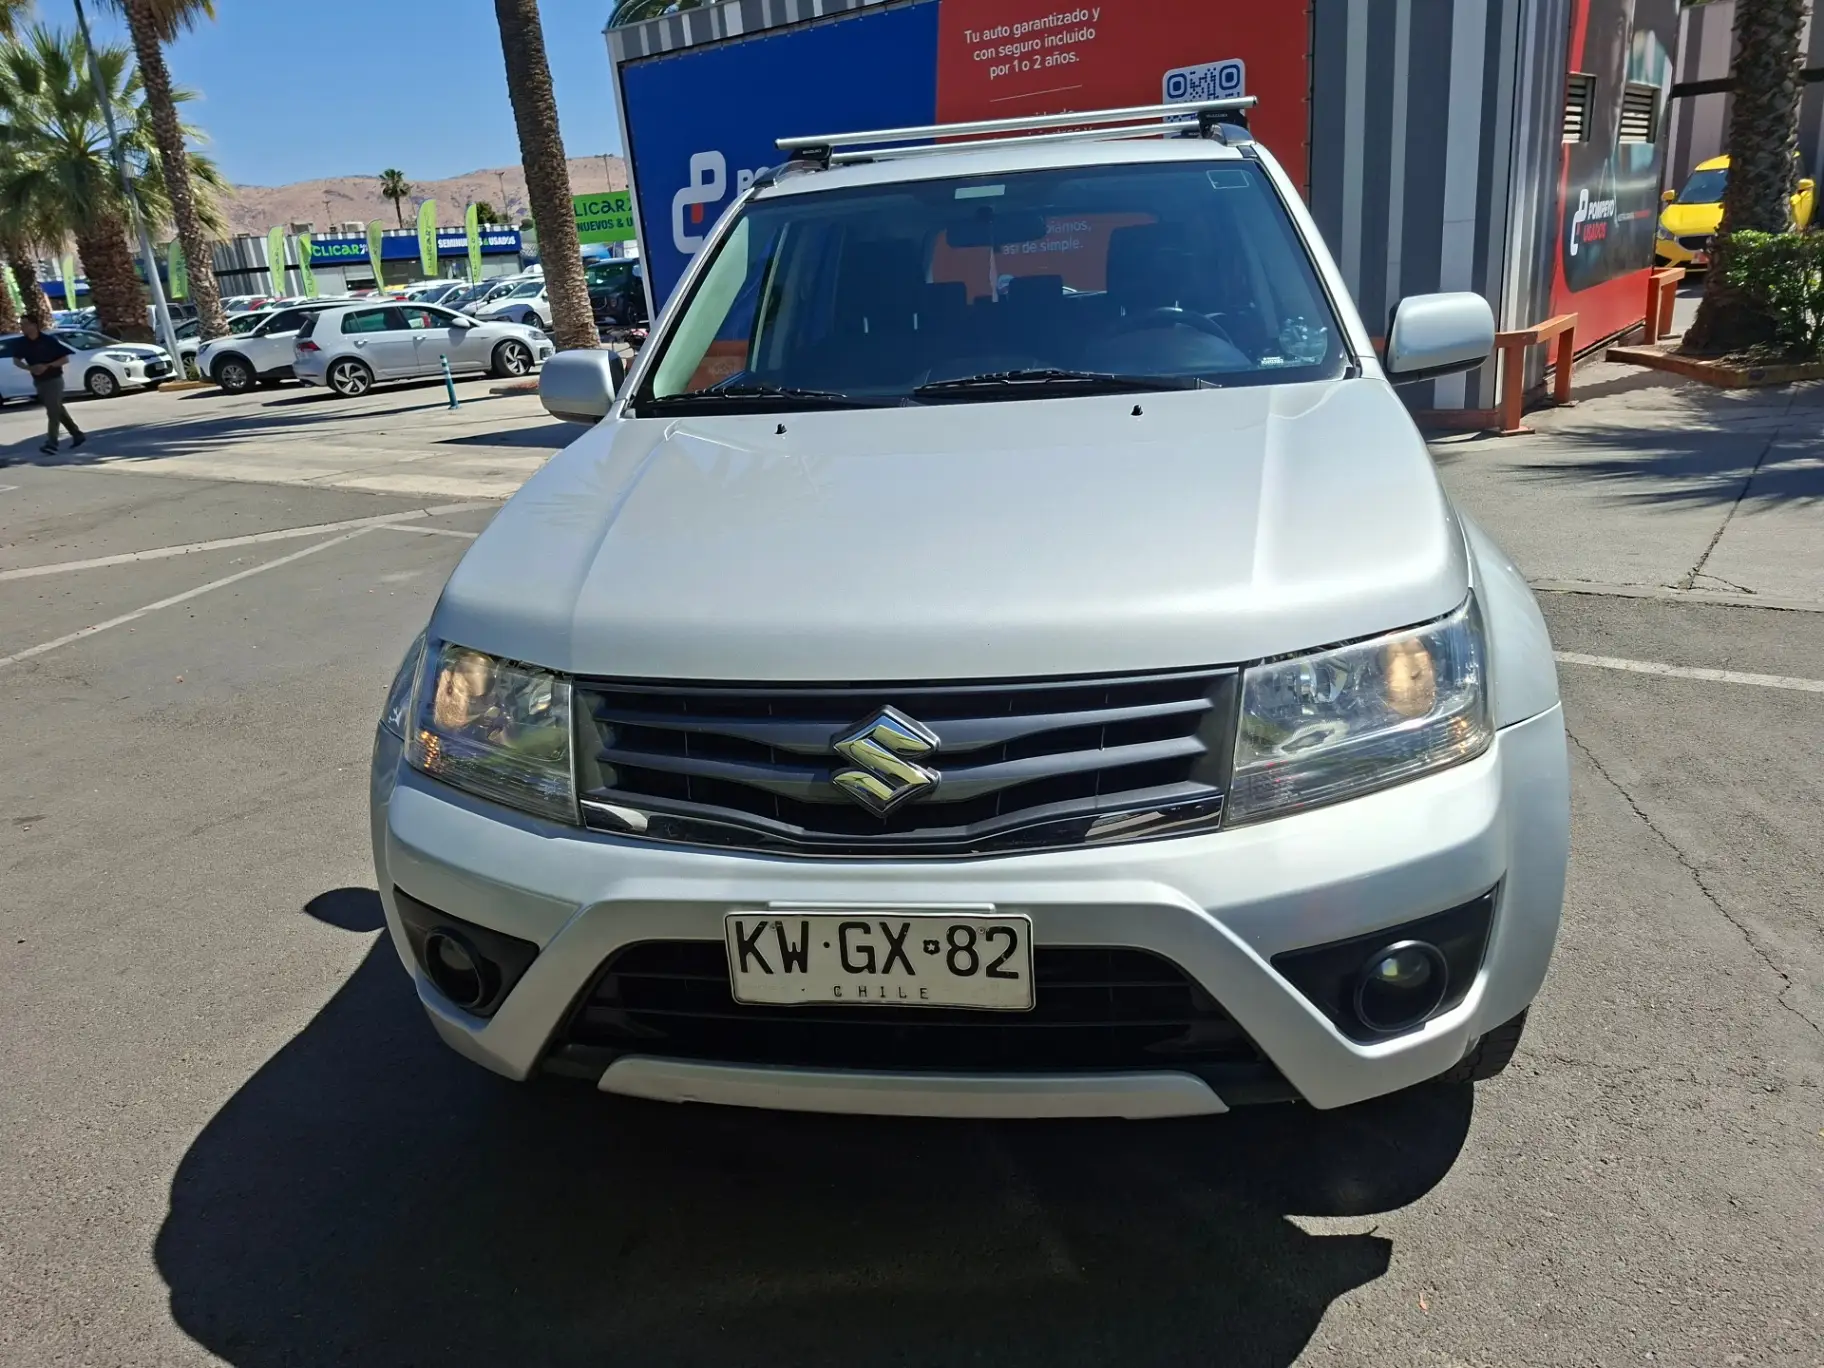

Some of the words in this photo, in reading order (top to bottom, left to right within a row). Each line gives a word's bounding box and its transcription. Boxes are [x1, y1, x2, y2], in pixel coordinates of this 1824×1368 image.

[964, 30, 980, 44] Tu
[982, 26, 1010, 41] auto
[1013, 8, 1089, 38] garantizado
[1092, 7, 1101, 22] y
[973, 48, 996, 61] con
[998, 38, 1041, 57] seguro
[1044, 27, 1096, 48] incluido
[989, 63, 1010, 80] por
[1013, 60, 1019, 73] 1
[1021, 60, 1030, 71] o
[1033, 55, 1042, 69] 2
[1045, 51, 1080, 67] años.
[1021, 240, 1037, 254] de
[1040, 235, 1084, 253] simple.
[833, 985, 929, 1000] CHILE
